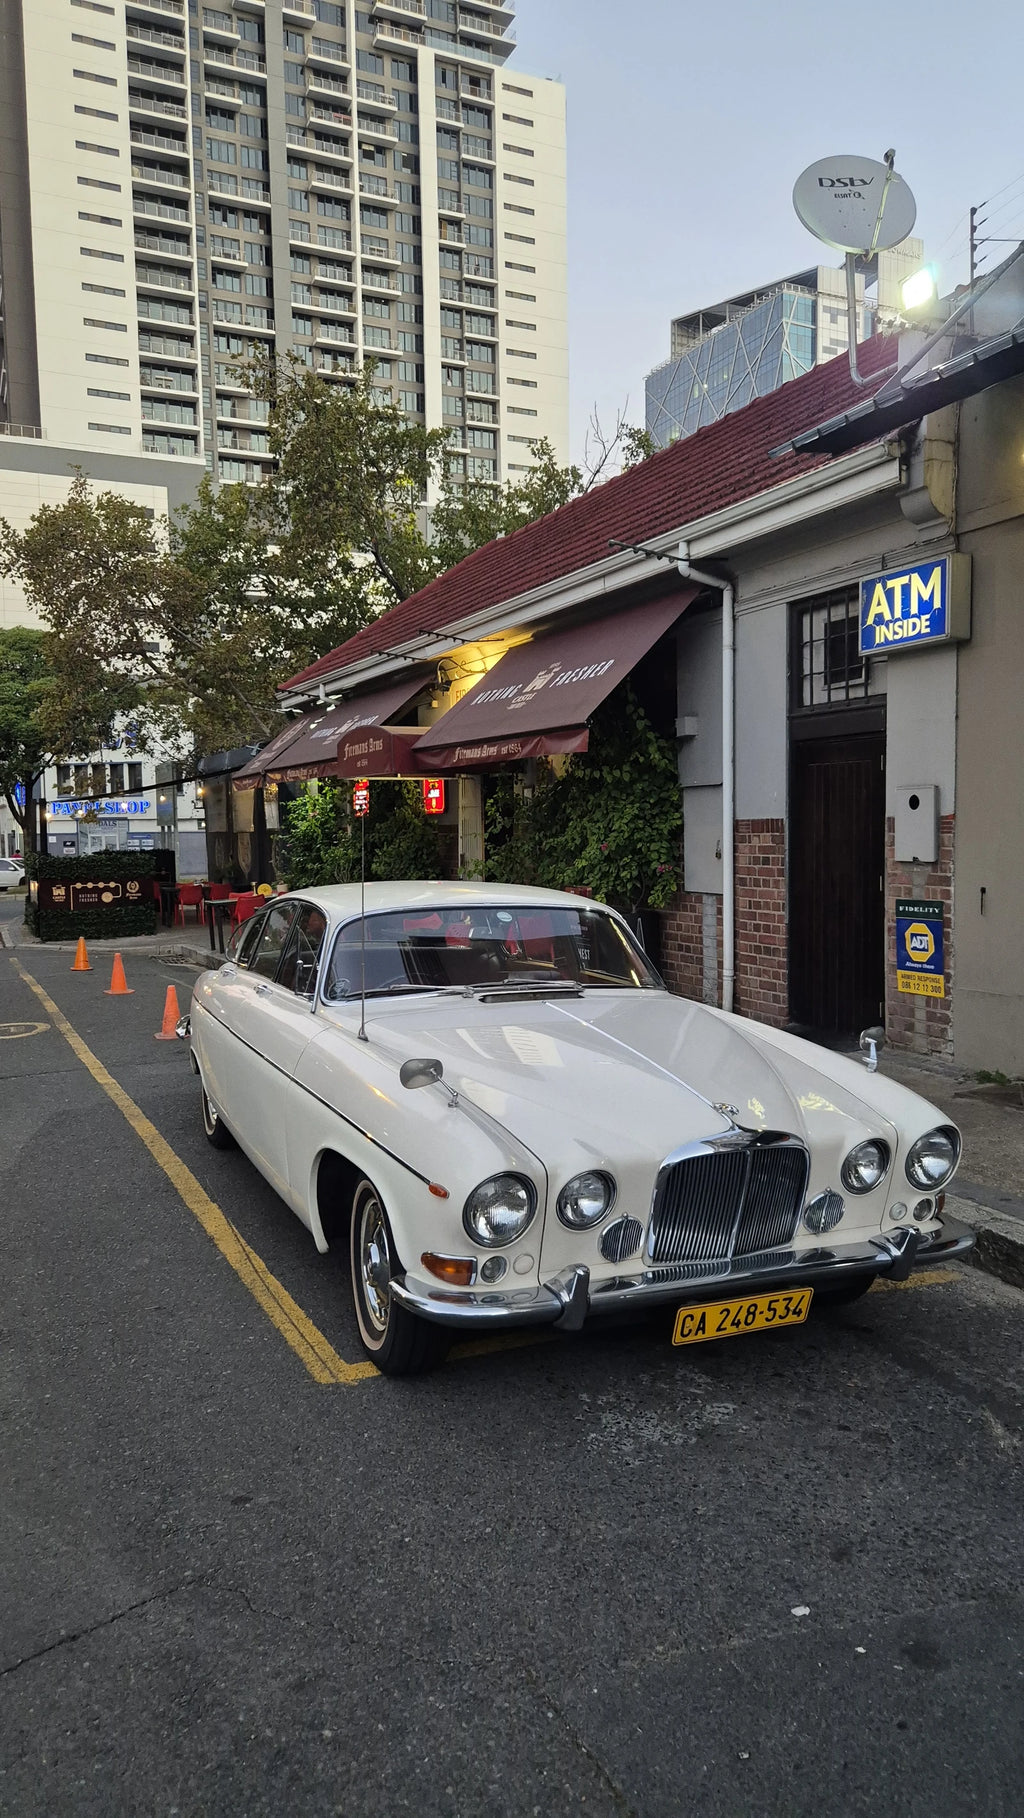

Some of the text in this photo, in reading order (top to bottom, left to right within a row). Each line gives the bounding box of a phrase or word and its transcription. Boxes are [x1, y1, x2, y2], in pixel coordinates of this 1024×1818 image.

[866, 565, 942, 626] ATM
[875, 614, 931, 644] INSIDE
[470, 683, 523, 706] NOTHING
[549, 659, 615, 688] FRESHER
[899, 905, 940, 914] FIDELITY
[911, 935, 929, 950] ADT
[905, 961, 921, 969] Always
[917, 975, 941, 984] RESPONSE
[913, 982, 920, 991] 12
[922, 984, 928, 992] 12
[931, 984, 942, 994] 300
[680, 1295, 805, 1338] CA 248-534
